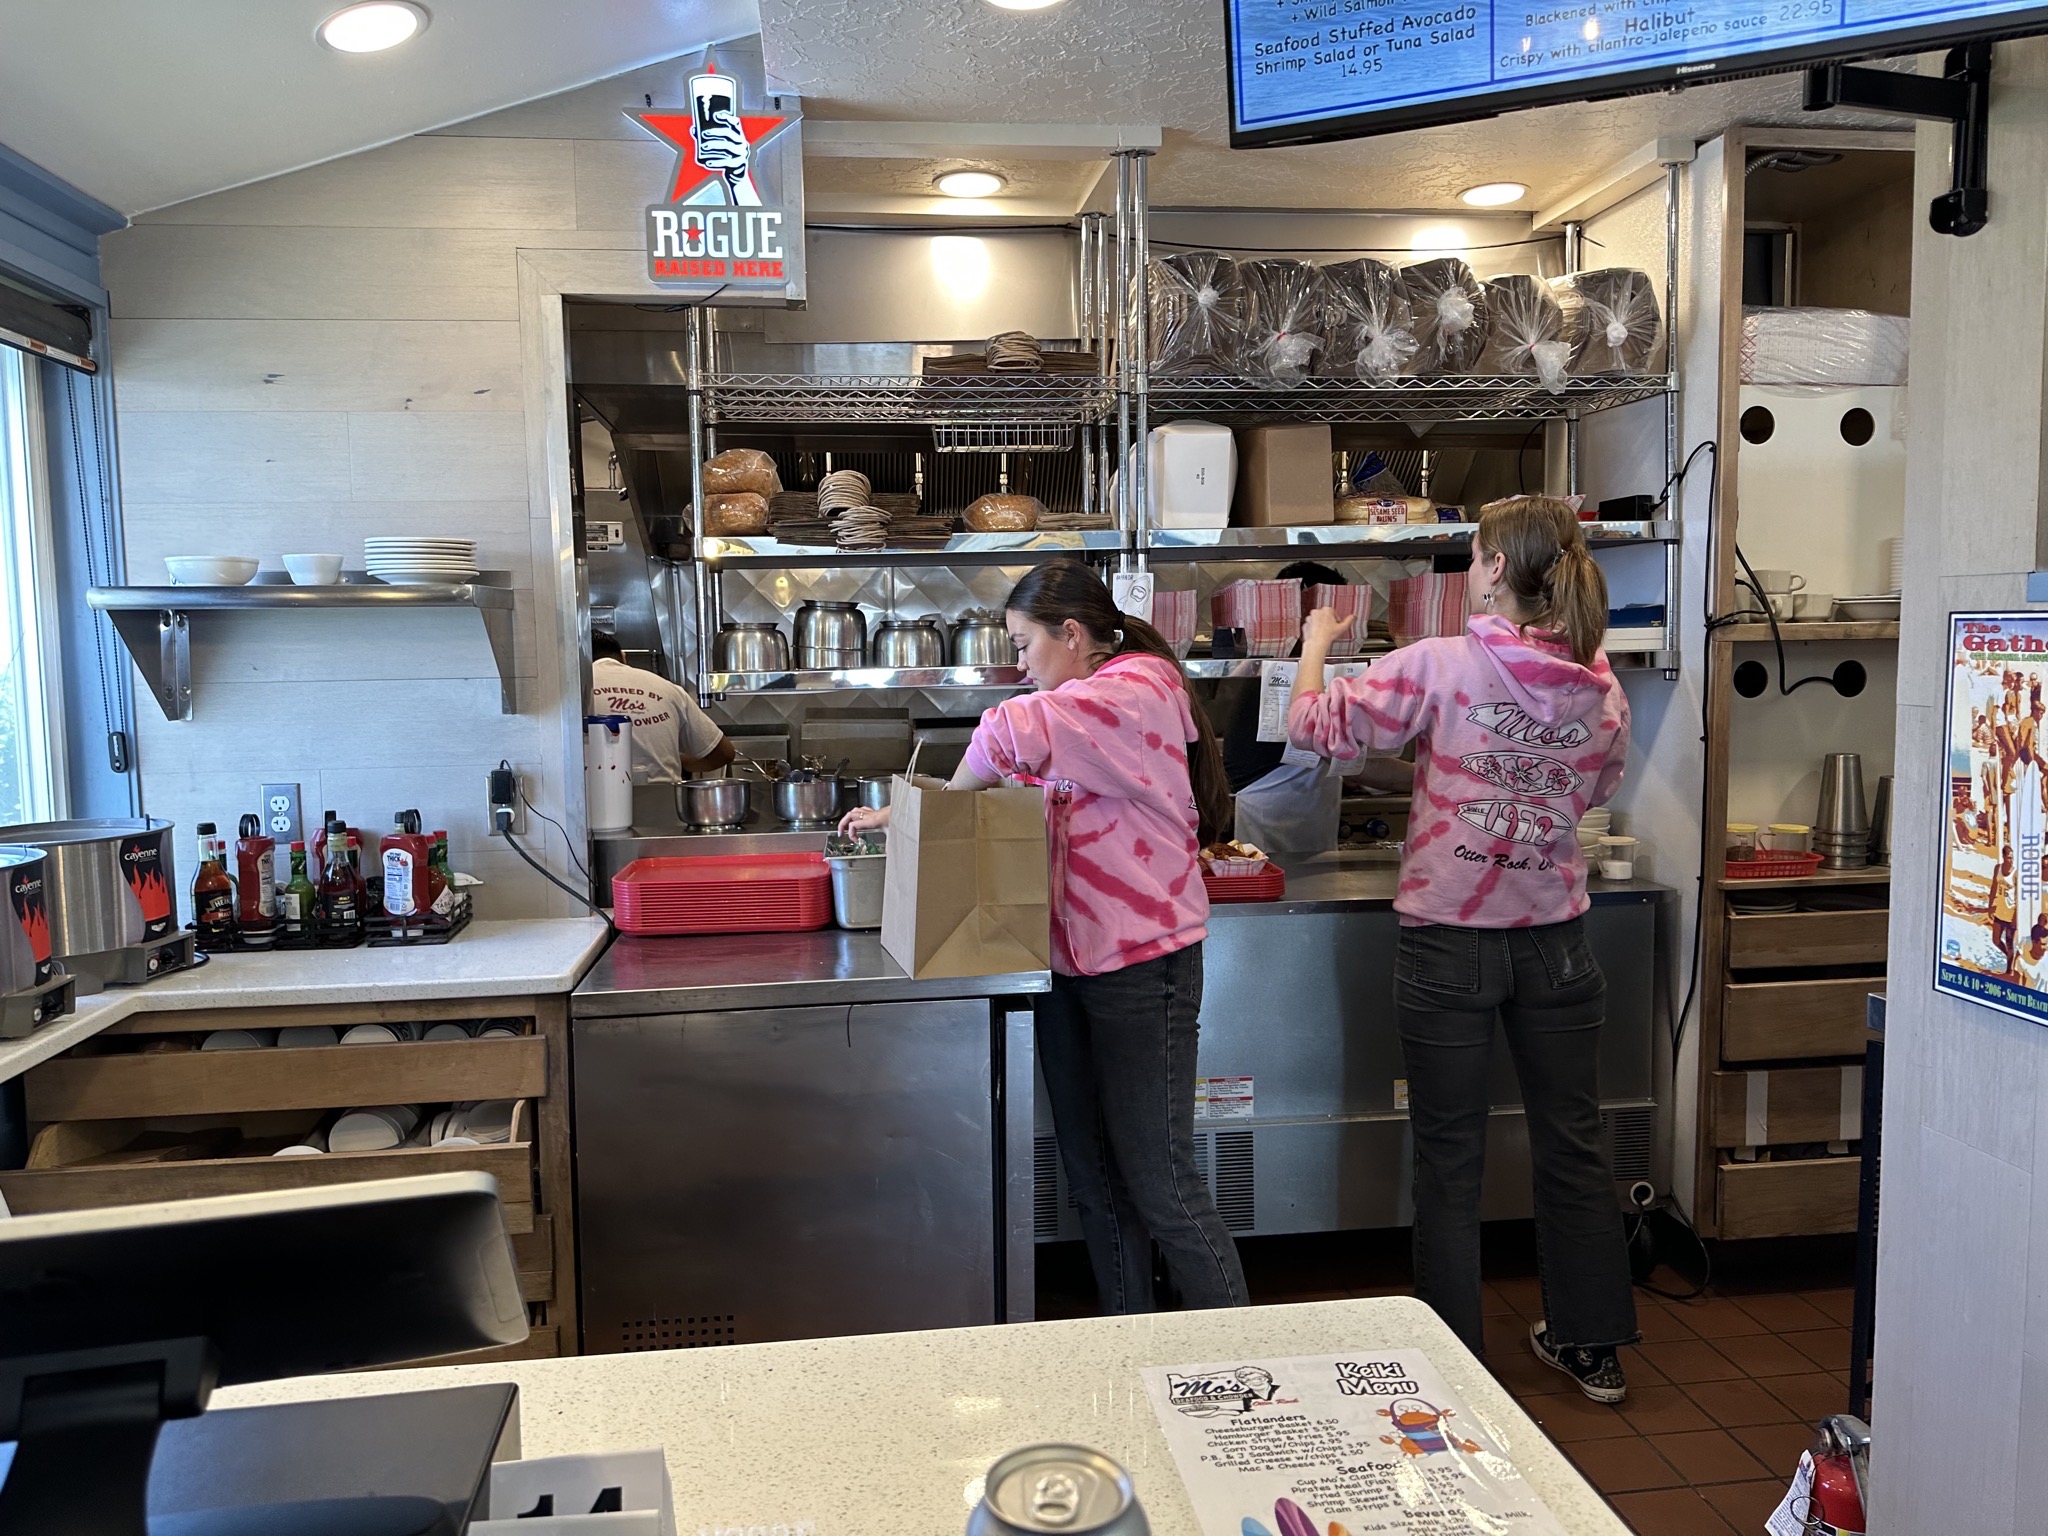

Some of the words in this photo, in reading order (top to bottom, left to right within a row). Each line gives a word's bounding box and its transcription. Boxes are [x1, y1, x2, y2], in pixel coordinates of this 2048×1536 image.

[1305, 5, 1337, 21] Wild
[1525, 5, 1597, 27] Blackened
[1625, 7, 1697, 33] Halibut
[1254, 32, 1320, 58] Seafood
[1329, 18, 1395, 44] Stuffed
[1401, 5, 1477, 31] Avocado
[1500, 51, 1544, 68] Crispy
[1550, 42, 1582, 59] with
[1724, 14, 1769, 32] sauce
[1780, 1, 1834, 22] 22.95
[1255, 57, 1306, 76] Shrimp
[1313, 45, 1356, 66] Salad
[1363, 43, 1380, 57] or
[1386, 36, 1422, 52] Tuna
[1430, 24, 1476, 46] Salad
[1341, 58, 1383, 78] 14.95
[1676, 61, 1717, 75] Hisense
[652, 210, 783, 258] ROGUE
[655, 260, 726, 277] RAISED
[733, 261, 784, 278] HERE
[1370, 507, 1391, 516] SESAME
[1391, 507, 1405, 515] SEED
[1963, 622, 2001, 633] The
[1963, 634, 2048, 652] Gath
[593, 687, 644, 695] OWERED
[648, 692, 663, 701] BY
[607, 697, 646, 710] Mo's
[633, 712, 670, 726] OWDER
[1485, 802, 1554, 847] 1972
[124, 848, 158, 861] cayenne
[1454, 845, 1488, 863] Otter
[1493, 854, 1531, 870] Rock,
[2021, 833, 2040, 900] ROGUE
[1957, 973, 1963, 985] 9
[1963, 976, 1970, 988] &
[1971, 978, 1980, 990] 10
[1336, 1362, 1406, 1379] Keiki
[1173, 1380, 1245, 1396] Mo's
[1336, 1378, 1420, 1396] Menu
[1204, 1424, 1274, 1435] Cheeseburger
[1278, 1421, 1312, 1429] Basket
[1316, 1418, 1339, 1426] 6.50
[1230, 1415, 1306, 1426] Flatlanders
[1207, 1439, 1248, 1447] Chicken
[1251, 1436, 1282, 1445] Strips
[1299, 1432, 1323, 1440] Fries
[1327, 1430, 1350, 1438] 5.95
[1214, 1430, 1270, 1440] Hamburger
[1274, 1427, 1309, 1435] Basket
[1249, 1449, 1298, 1457] Sandwich
[1301, 1444, 1344, 1453] w/Chips
[1347, 1441, 1370, 1449] 3.95
[1250, 1444, 1270, 1452] Dog
[1274, 1439, 1315, 1449] w/Chips
[1214, 1459, 1250, 1468] Grilled
[1254, 1456, 1292, 1464] Cheese
[1340, 1449, 1364, 1457] 4.50
[1278, 1461, 1315, 1469] Cheese
[1319, 1458, 1343, 1466] 4.95
[1291, 1485, 1331, 1494] Pirates
[1335, 1482, 1361, 1490] Meal
[1365, 1478, 1391, 1487] (Fish
[1441, 1471, 1466, 1480] 5.95
[1296, 1479, 1317, 1487] Cup
[1320, 1475, 1346, 1483] Mo's
[1349, 1473, 1376, 1481] Clam
[1427, 1466, 1452, 1474] 5.95
[1306, 1498, 1345, 1508] Shrimp
[1349, 1493, 1389, 1504] Skewer
[1312, 1492, 1340, 1500] Fried
[1344, 1487, 1382, 1497] Shrimp
[1323, 1506, 1352, 1514] Clam
[1355, 1501, 1389, 1512] Strips
[1363, 1524, 1388, 1532] Kids
[1390, 1520, 1415, 1529] Size
[1406, 1526, 1438, 1535] Apple
[1441, 1523, 1471, 1532] Juice
